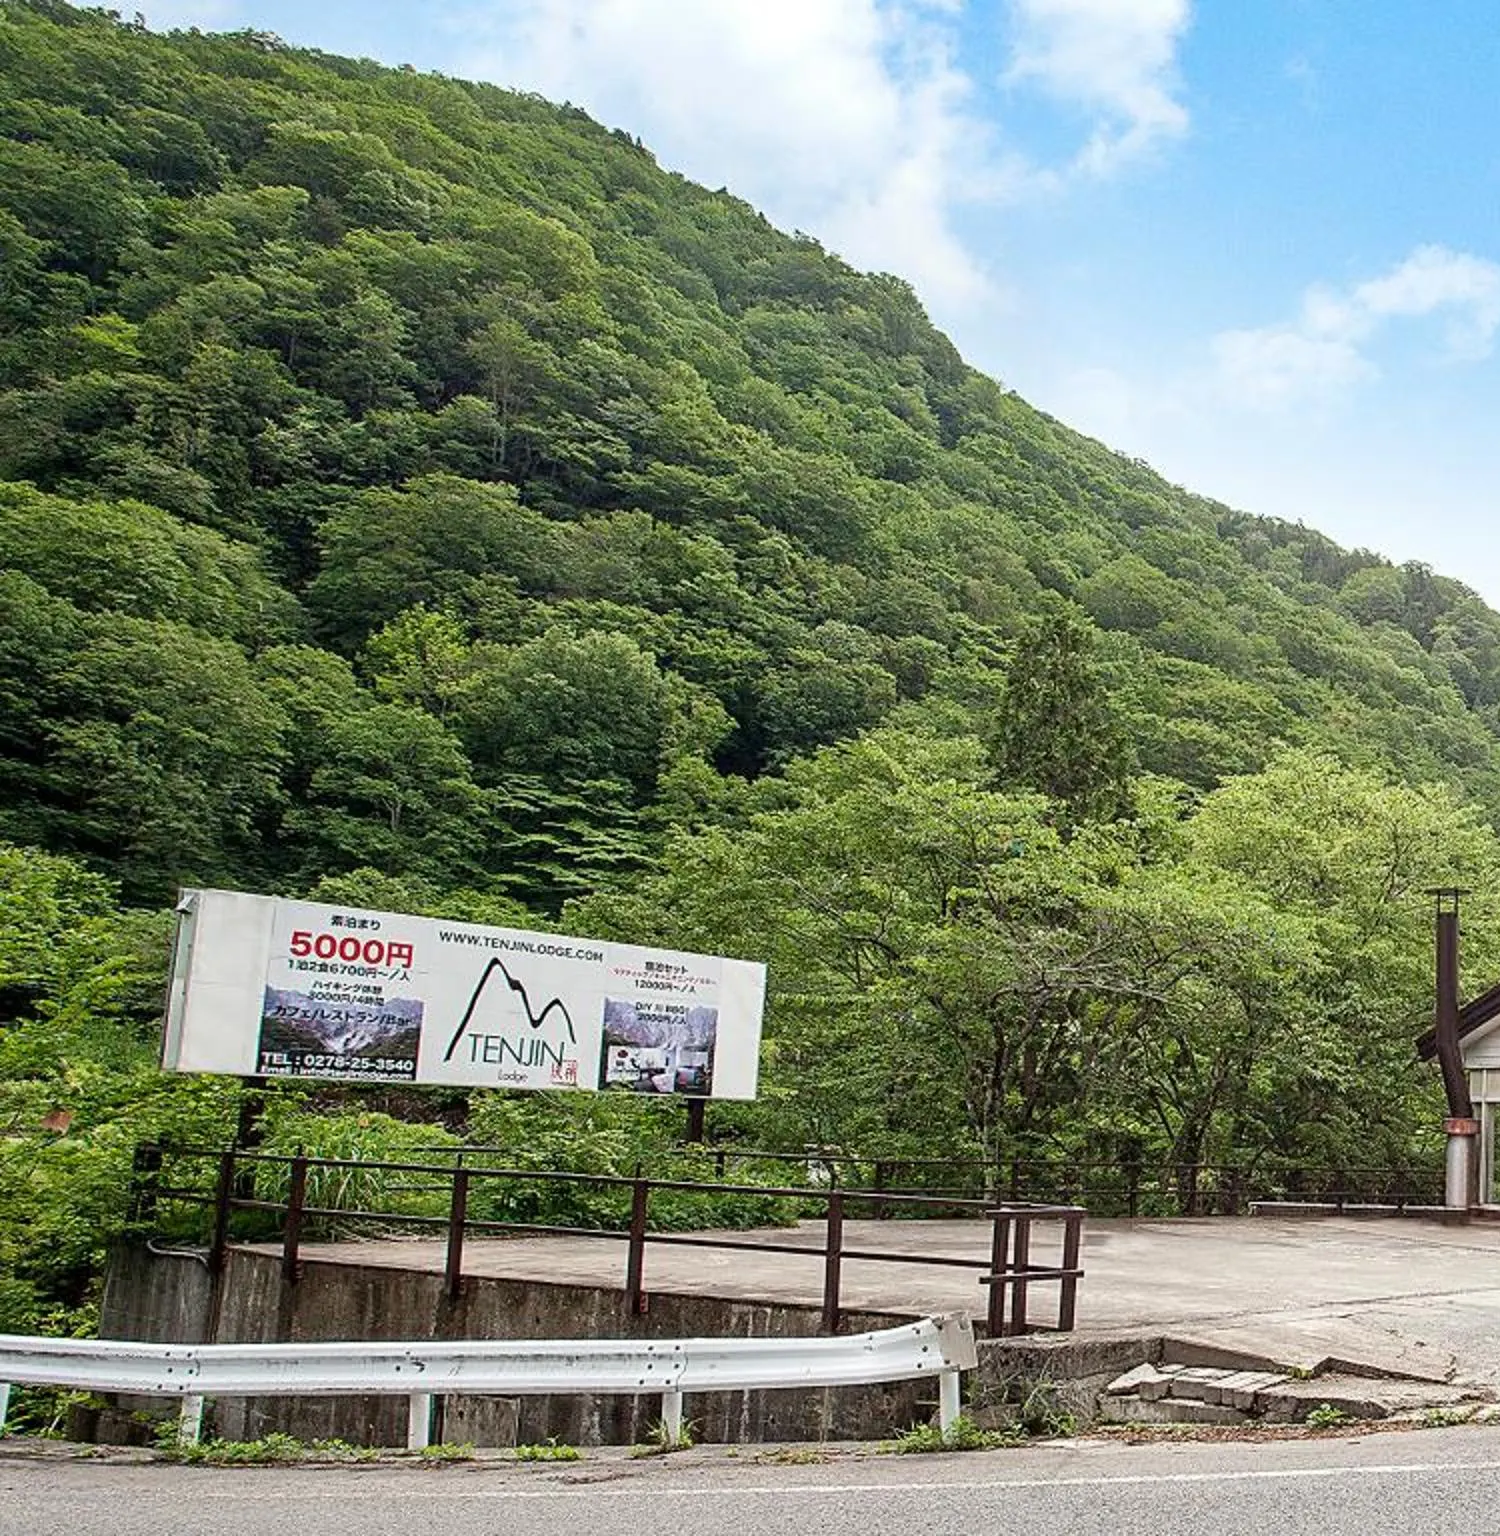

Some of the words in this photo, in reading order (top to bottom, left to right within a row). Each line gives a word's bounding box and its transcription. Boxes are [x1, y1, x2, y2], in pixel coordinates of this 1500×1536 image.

[290, 931, 414, 969] 5000円
[439, 931, 603, 962] WWW.TENJINLODGE.COM
[304, 1054, 414, 1072] 0278-25-3540
[468, 1033, 565, 1067] TENJIN
[498, 1069, 528, 1083] Lodge
